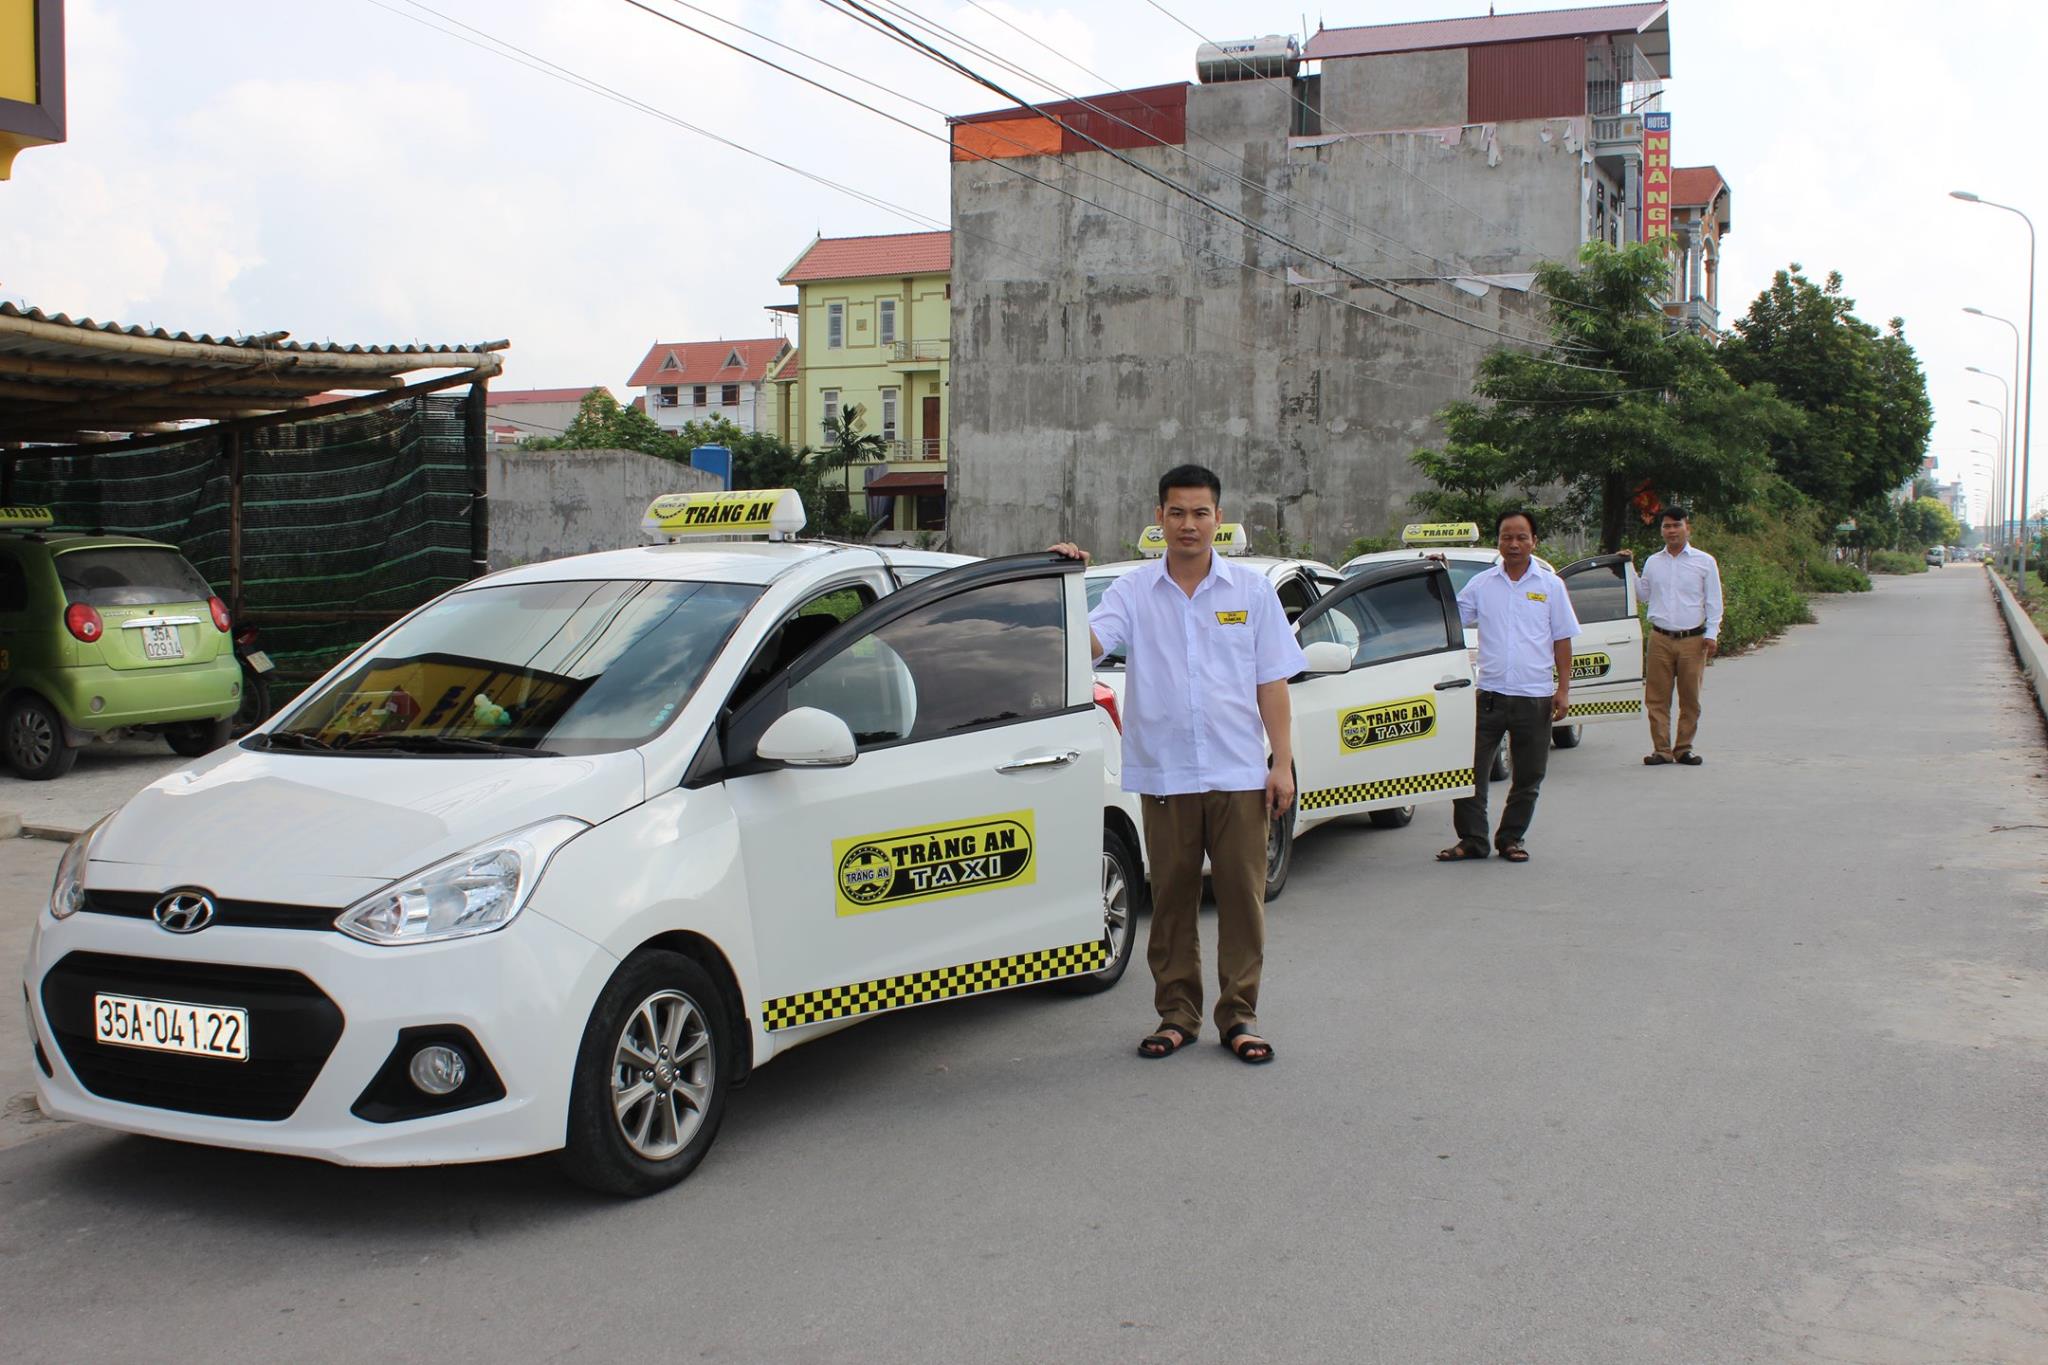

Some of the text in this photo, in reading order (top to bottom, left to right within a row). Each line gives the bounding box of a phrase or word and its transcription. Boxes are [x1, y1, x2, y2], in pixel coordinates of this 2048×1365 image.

[1647, 117, 1669, 129] HOTEL
[1647, 137, 1669, 184] NHÀ
[745, 502, 774, 523] AN
[1456, 528, 1470, 536] AN
[152, 625, 172, 642] 35A
[1593, 655, 1605, 665] AN
[1366, 704, 1427, 727] TRÀNG AN
[1375, 720, 1421, 741] TAXI
[891, 828, 1016, 867] TRÀNG AN
[845, 866, 890, 884] TRÀNG AN
[909, 855, 1003, 891] TAXI
[100, 999, 241, 1054] 35A-041.22
